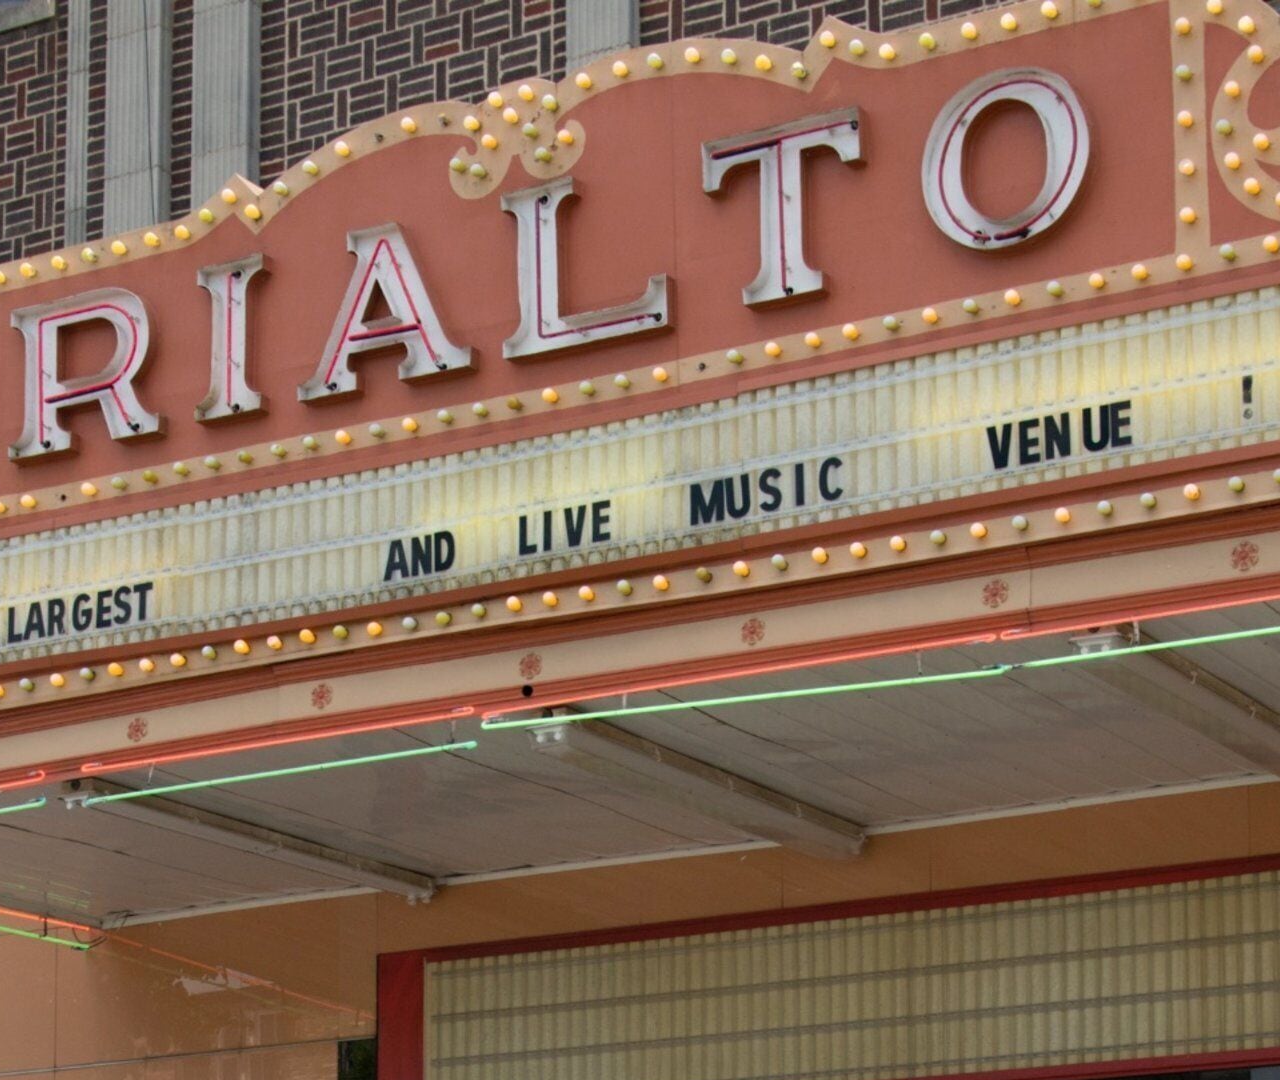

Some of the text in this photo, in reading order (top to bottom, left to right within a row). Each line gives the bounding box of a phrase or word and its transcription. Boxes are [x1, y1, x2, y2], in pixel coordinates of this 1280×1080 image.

[8, 66, 1093, 463] RIALTO
[6, 581, 154, 644] LARGEST
[383, 530, 456, 581] AND
[519, 500, 612, 556] LIVE
[689, 456, 844, 527] MUSIC
[986, 400, 1133, 469] VENUE
